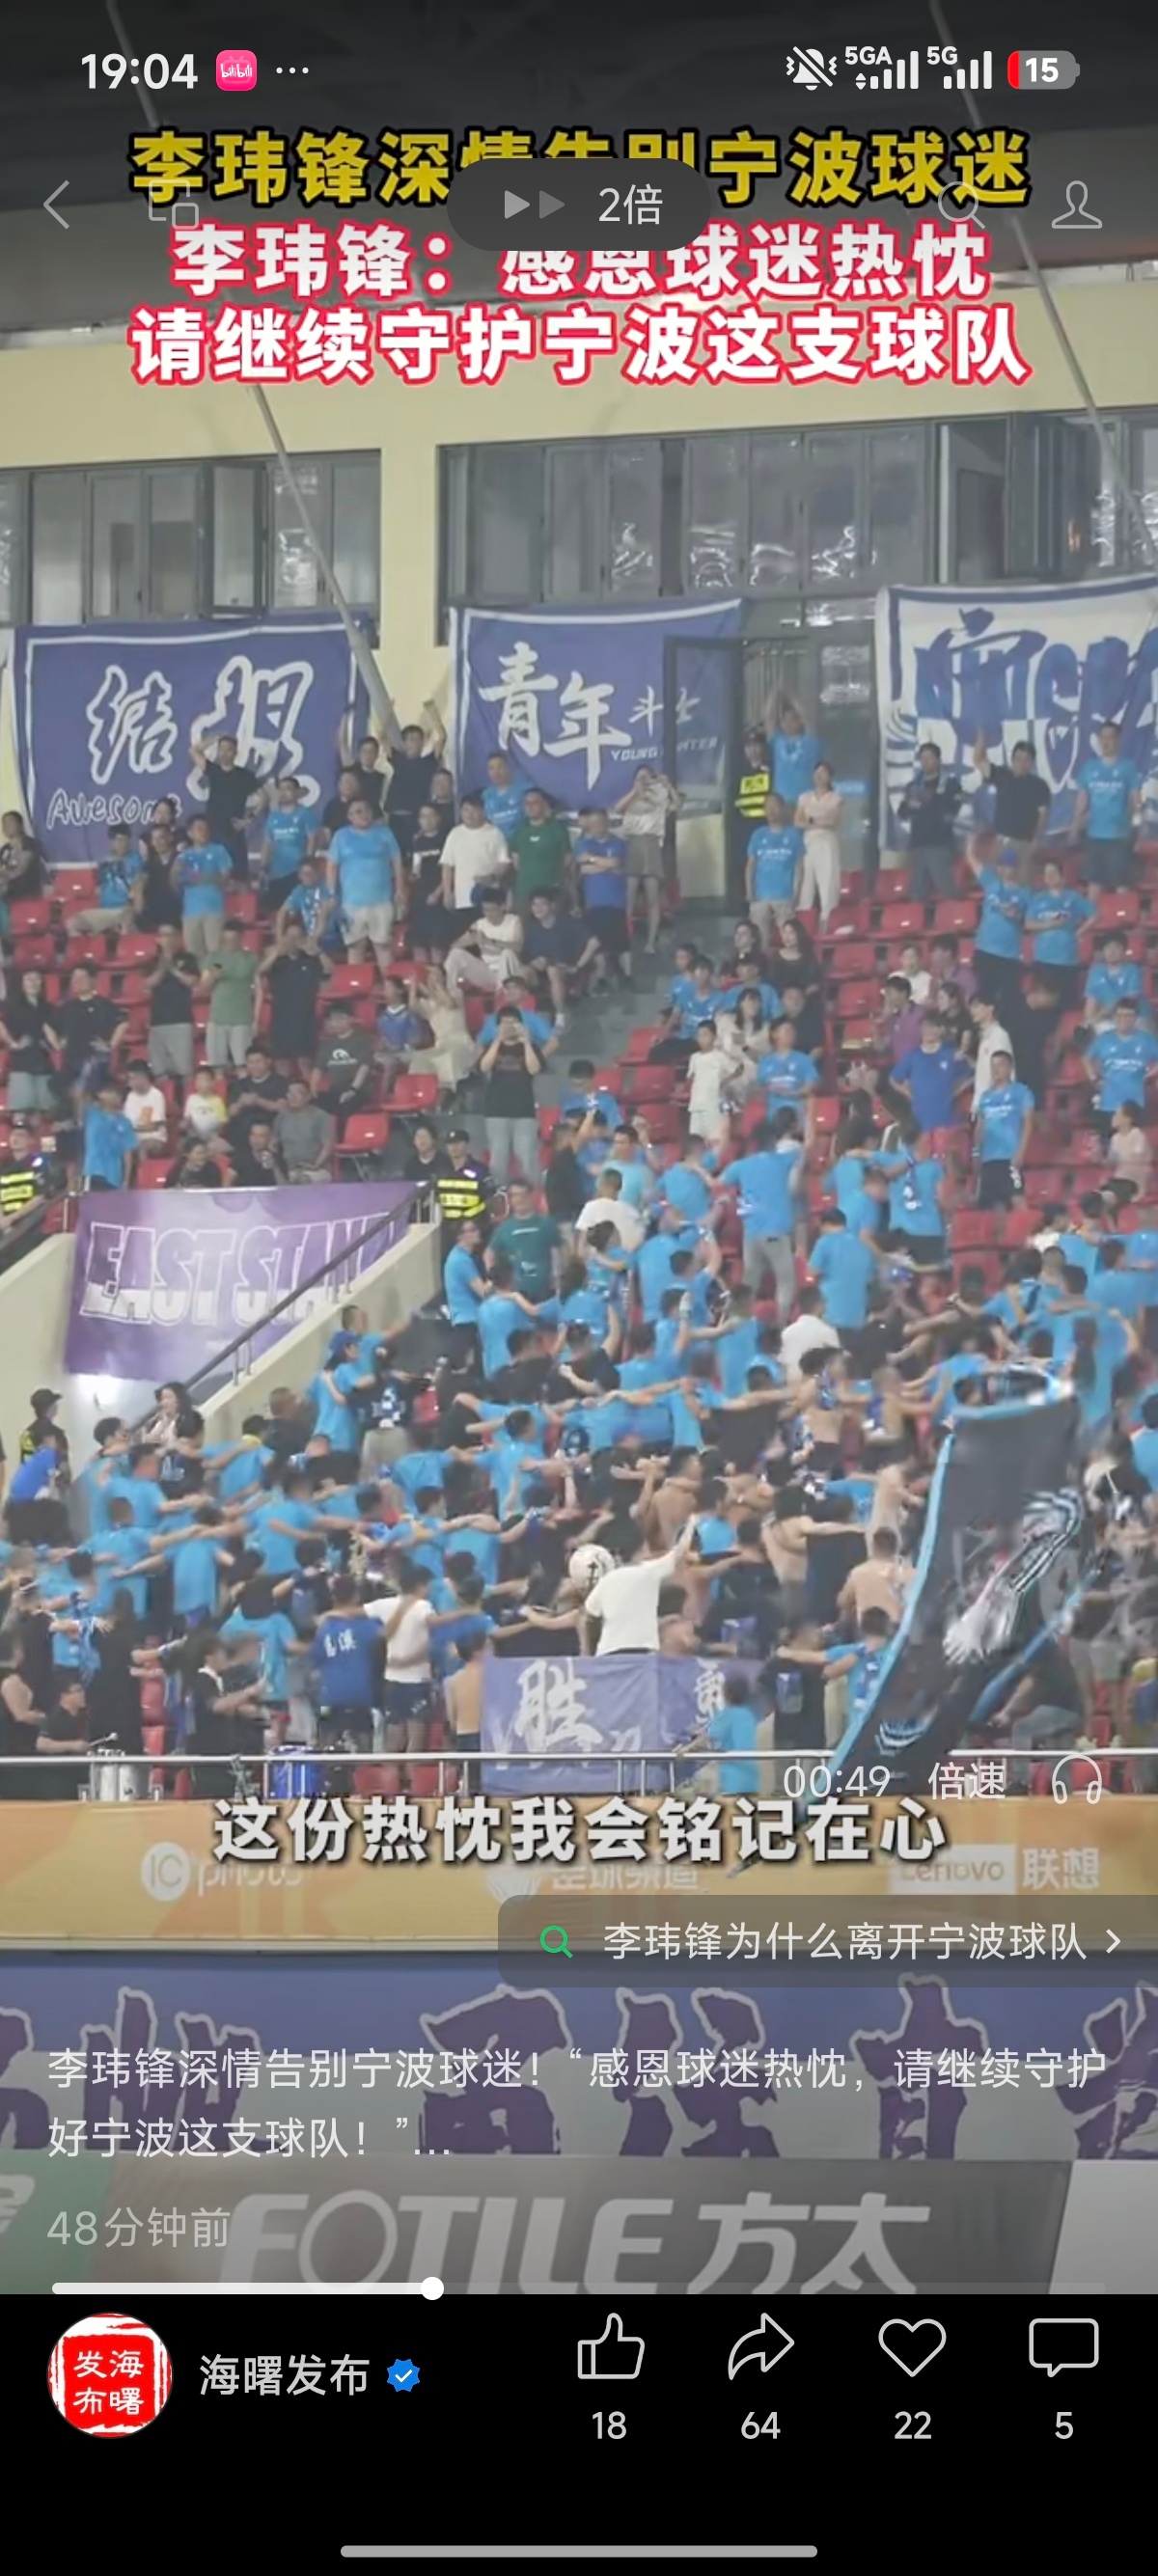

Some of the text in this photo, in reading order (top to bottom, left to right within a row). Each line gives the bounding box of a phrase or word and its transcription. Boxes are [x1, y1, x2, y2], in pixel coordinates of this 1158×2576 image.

[611, 745, 659, 762] YOUNG
[79, 1220, 237, 1327] EAST
[1021, 1847, 1101, 1892] 联想
[216, 2188, 930, 2295] FOTILE 方太
